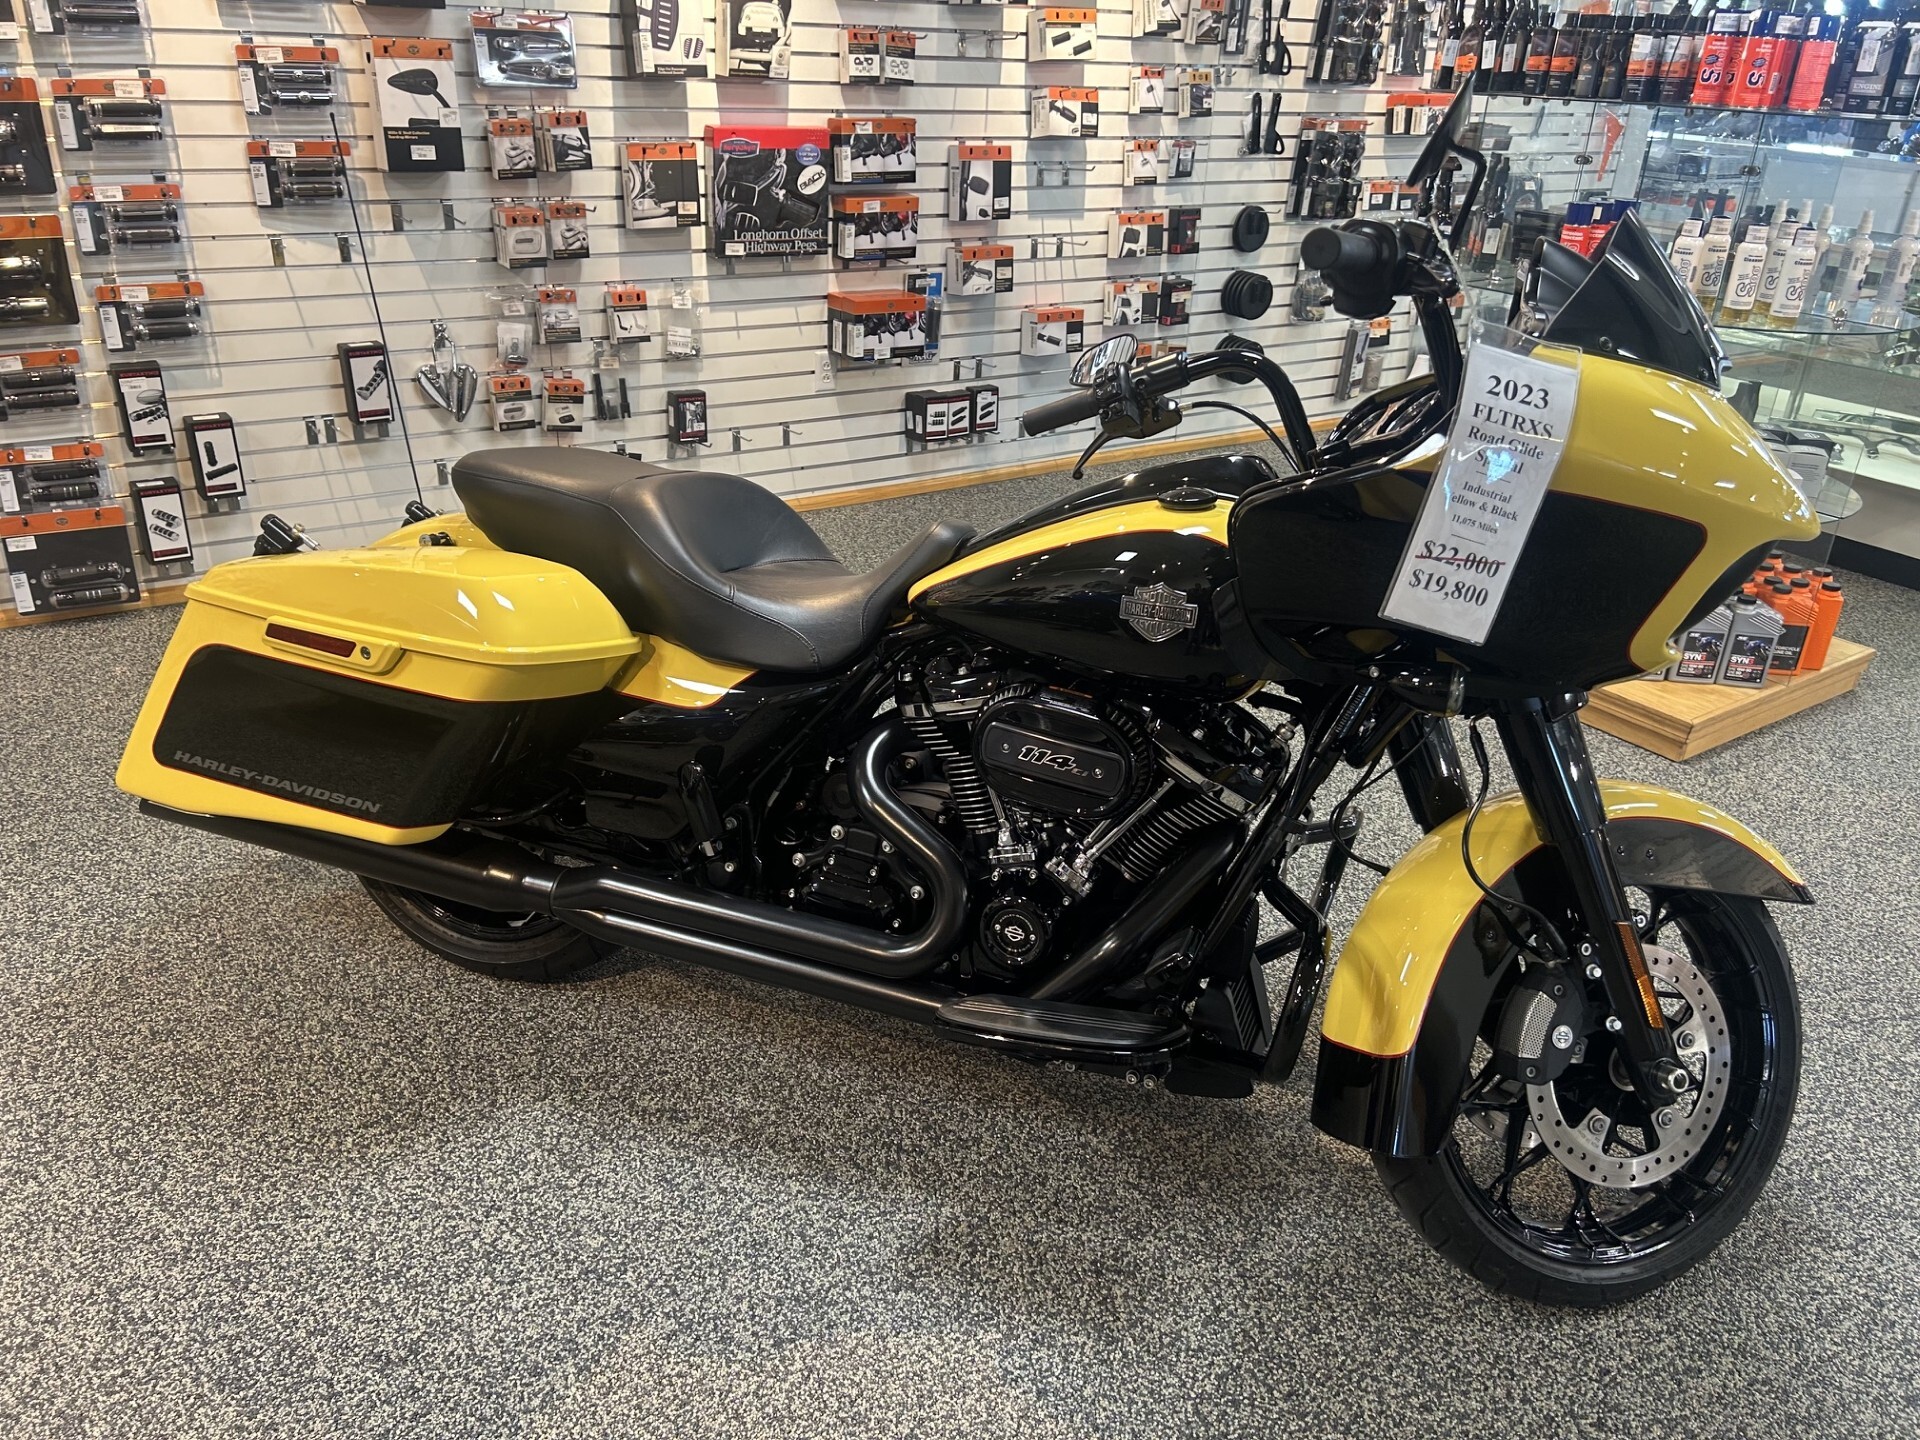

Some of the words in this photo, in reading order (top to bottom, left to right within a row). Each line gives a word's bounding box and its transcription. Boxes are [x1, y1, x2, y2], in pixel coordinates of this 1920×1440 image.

[734, 229, 789, 243] Longhorn
[790, 228, 824, 240] Offset
[745, 241, 793, 254] Highway
[794, 240, 818, 253] Pegs
[1486, 375, 1549, 410] 2023
[1472, 402, 1553, 440] FLTRXS
[1468, 425, 1505, 446] Road
[1508, 438, 1545, 461] Glide
[1474, 449, 1524, 475] Spal
[1462, 481, 1512, 505] Industrial
[1451, 514, 1477, 529] 11,075
[1476, 521, 1499, 535] Miles
[1479, 501, 1488, 512] &
[1490, 504, 1519, 522] Black
[1419, 539, 1501, 579] $22,000
[1408, 568, 1489, 607] $19,800
[1125, 602, 1192, 622] HARLEY-DAVIDSON
[1730, 656, 1756, 666] SYN3
[1017, 745, 1076, 772] 114
[174, 750, 381, 813] HARLEY-DAVIDSON
